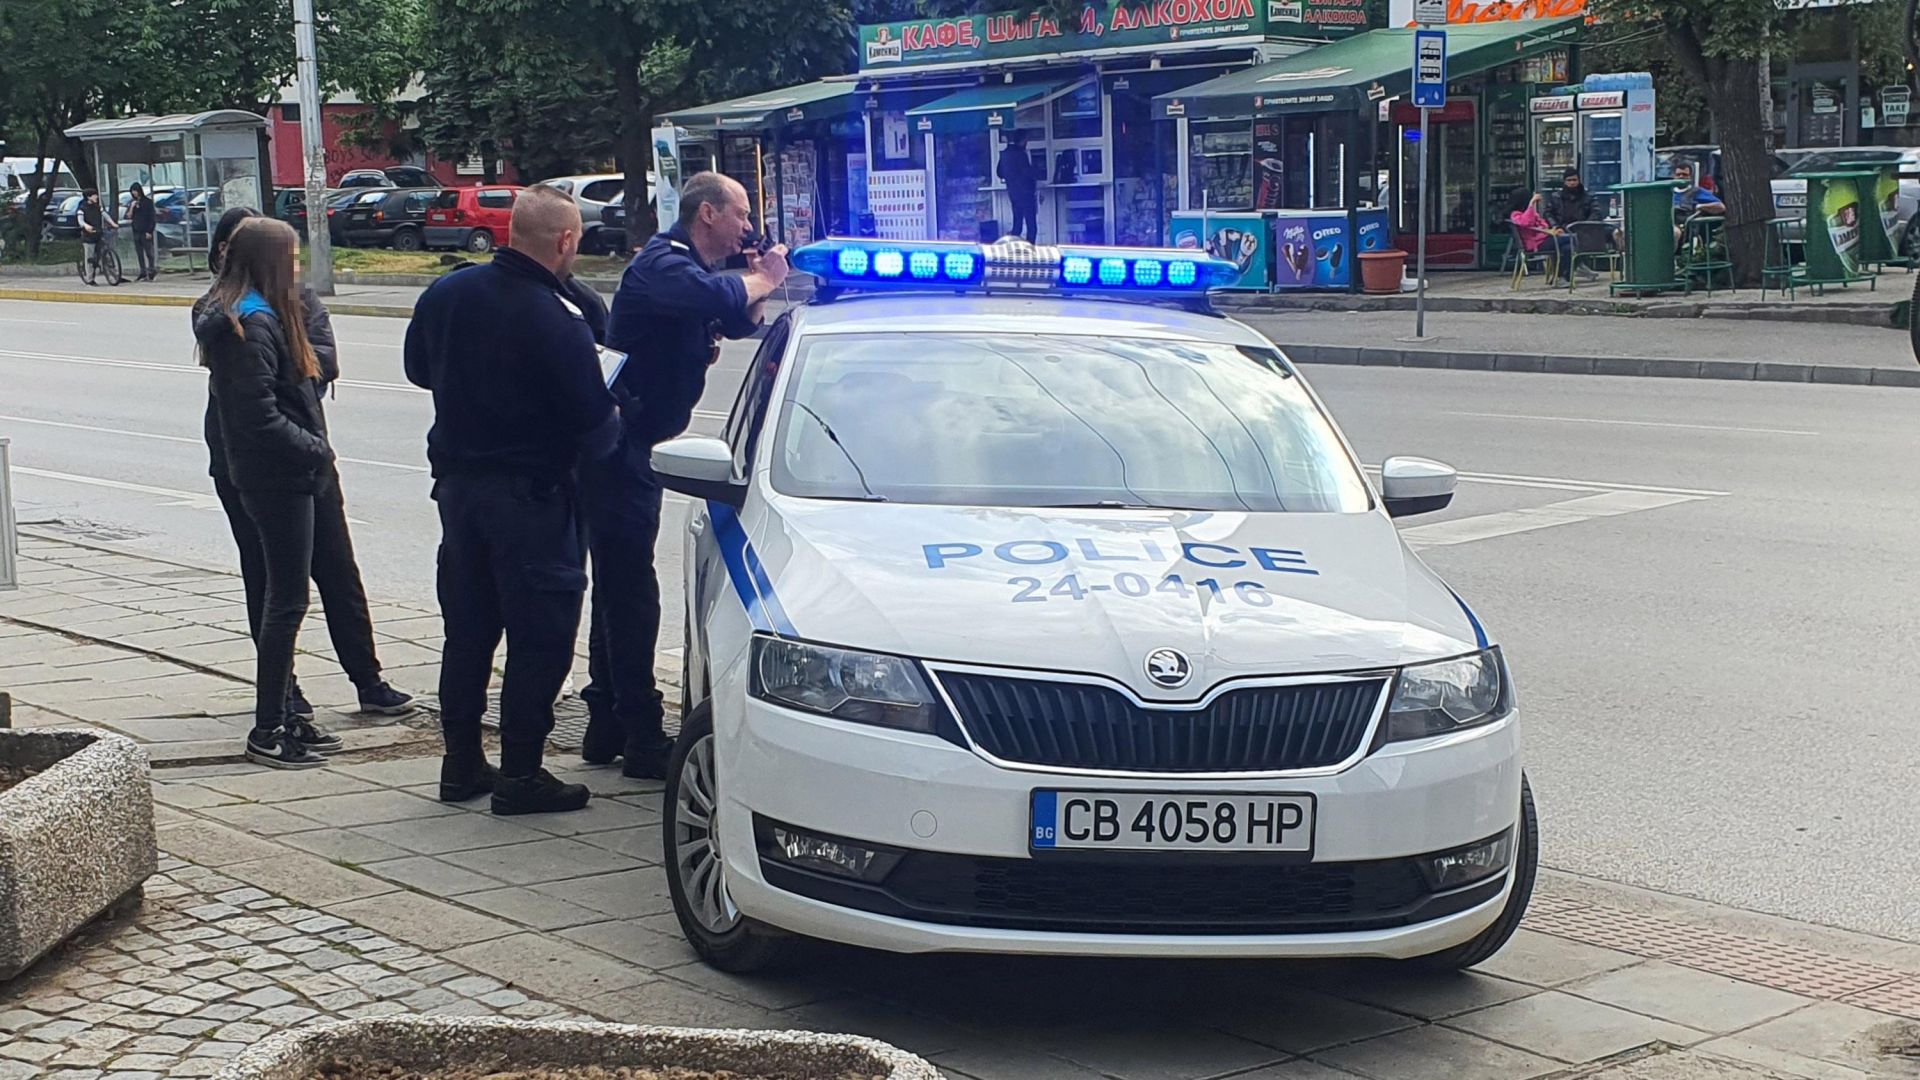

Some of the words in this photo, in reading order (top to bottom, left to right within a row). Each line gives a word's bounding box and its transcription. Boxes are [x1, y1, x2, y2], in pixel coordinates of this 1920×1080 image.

[902, 19, 981, 50] КАФЕ,
[986, 7, 1105, 43] ЦИГАИ,
[1111, 0, 1255, 31] АЛКОХОЛ
[1303, 8, 1367, 24] АЛКОХОЛ
[1885, 104, 1906, 112] TAKE
[1313, 227, 1342, 240] OREO
[922, 538, 1320, 576] POLICE
[1007, 572, 1274, 607] 24-0416
[1035, 826, 1054, 840] BG
[1064, 798, 1120, 842] CB
[1131, 801, 1237, 844] 4058
[1247, 802, 1303, 844] HP
